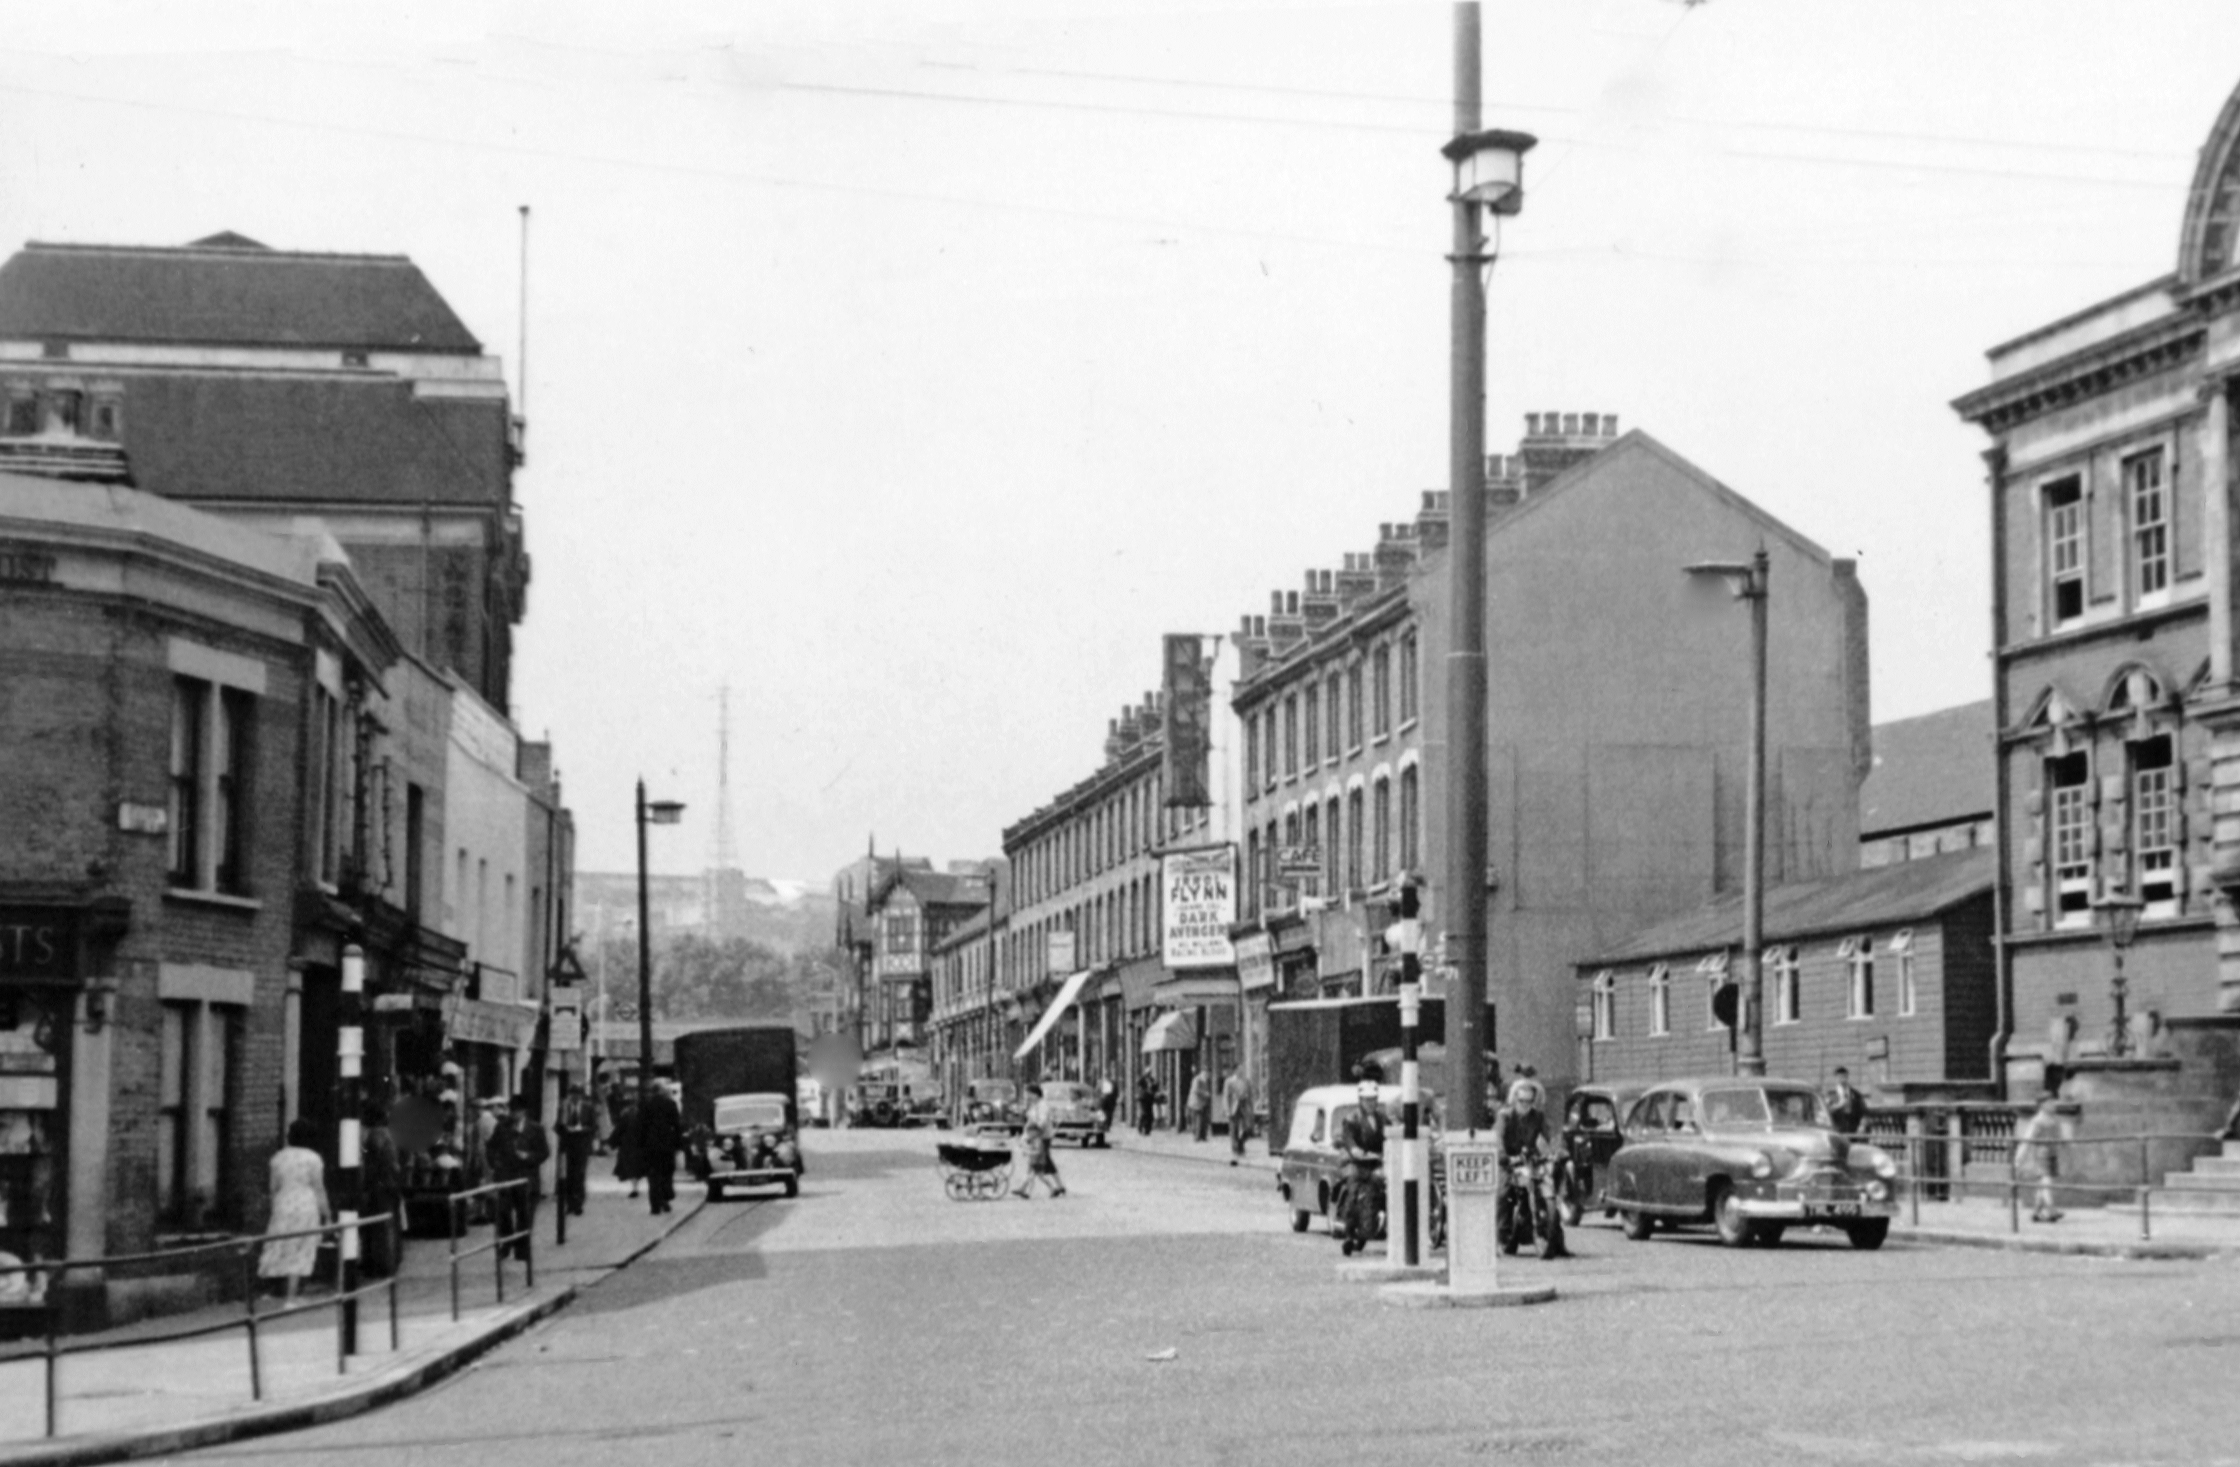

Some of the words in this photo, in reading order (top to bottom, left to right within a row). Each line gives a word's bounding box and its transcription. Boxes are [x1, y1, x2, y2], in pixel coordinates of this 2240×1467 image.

[1170, 882, 1227, 902] FLYNN
[1179, 911, 1219, 924] DARK
[0, 925, 54, 965] TS
[1457, 1157, 1490, 1168] KEEP
[1457, 1170, 1489, 1183] LEFT
